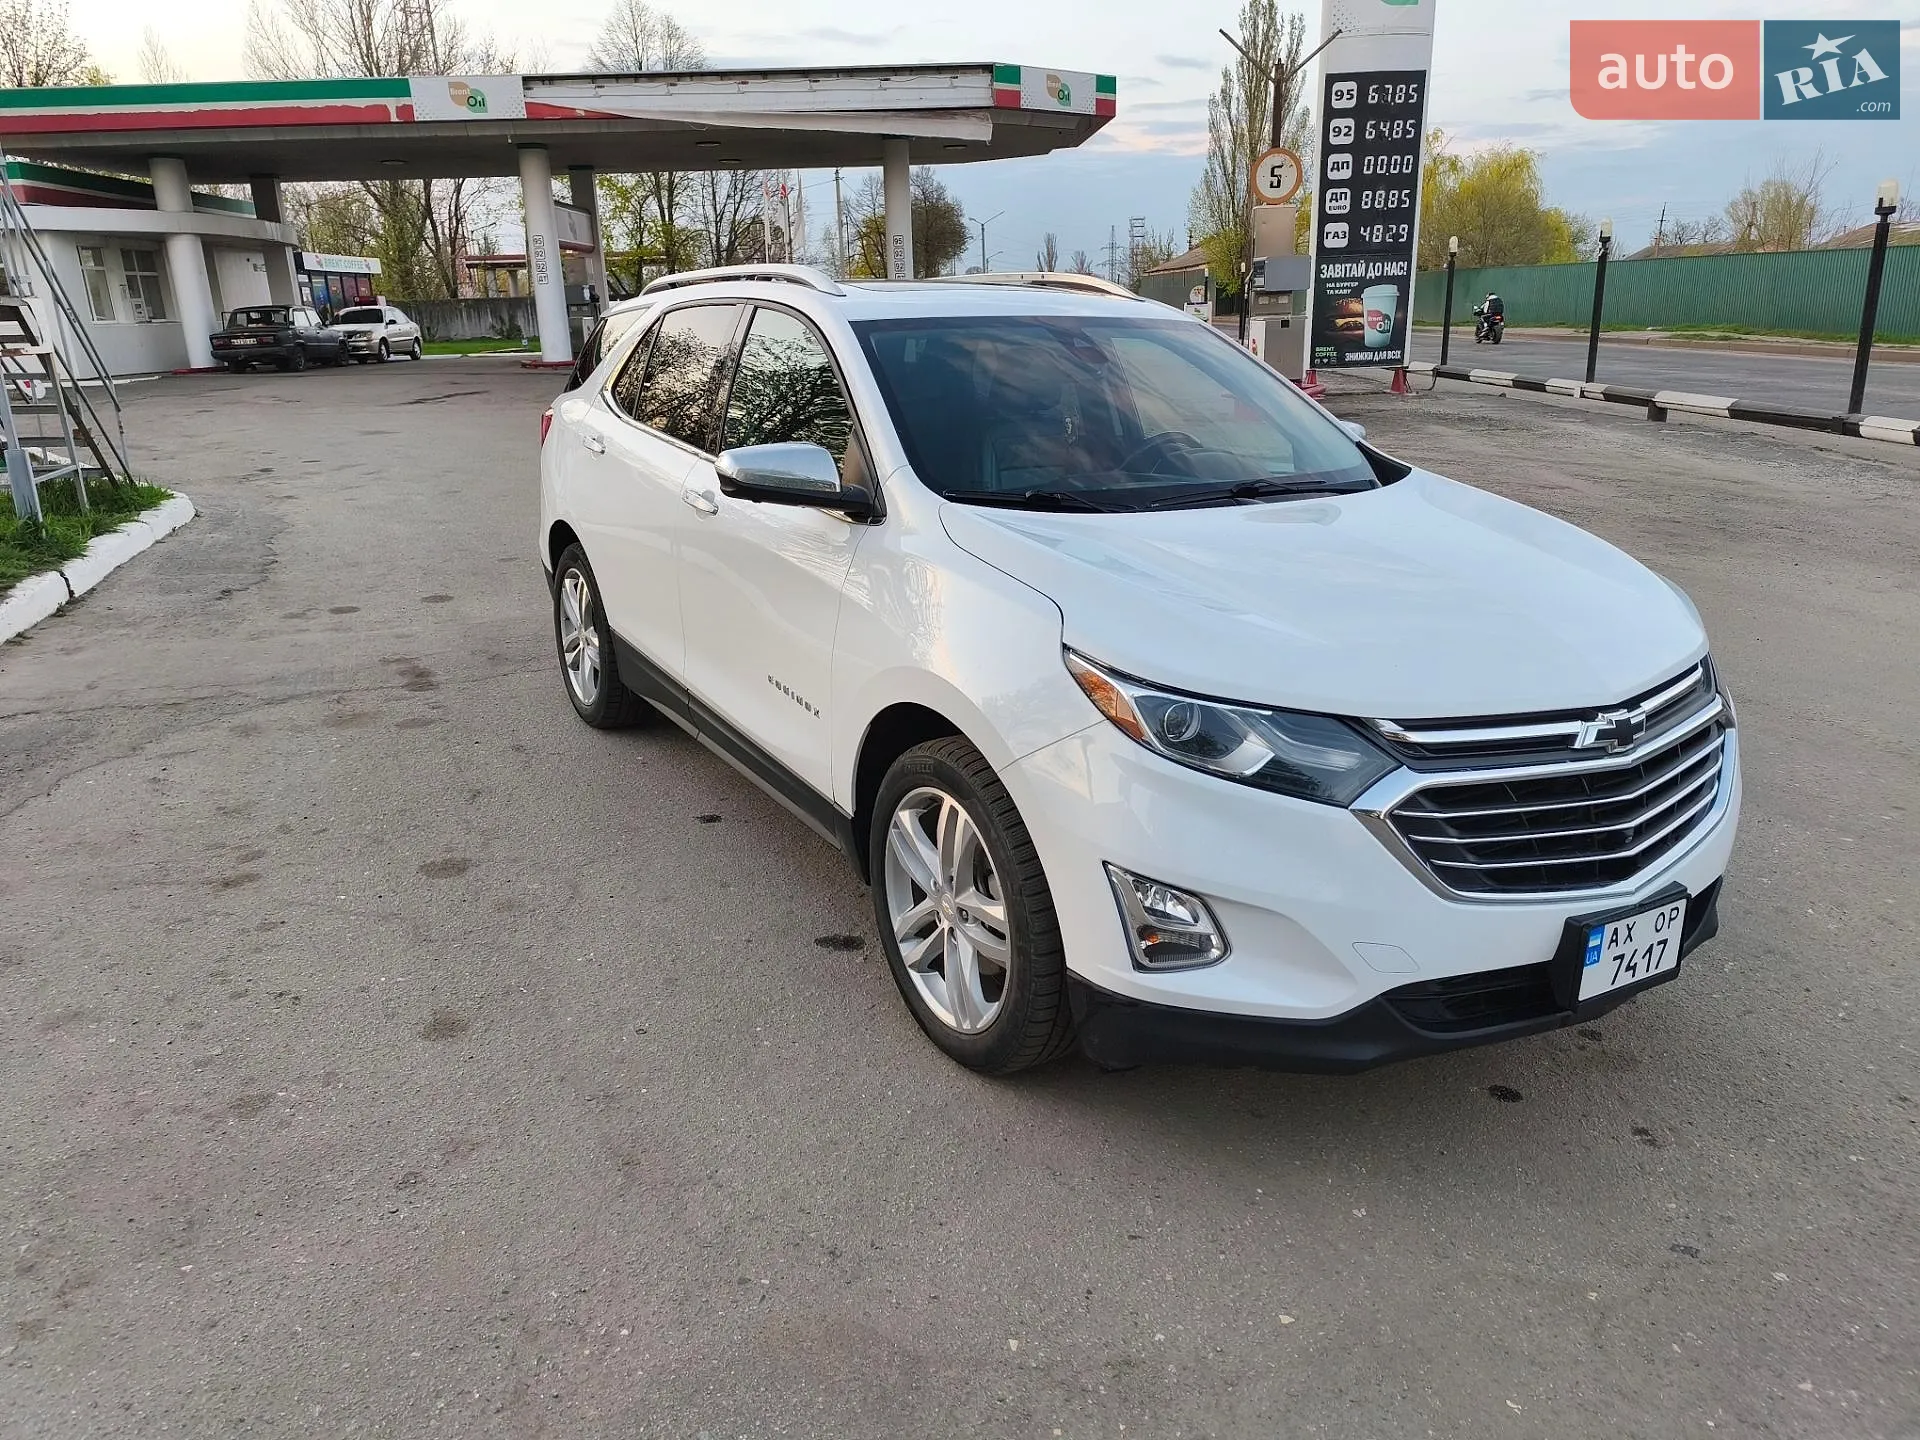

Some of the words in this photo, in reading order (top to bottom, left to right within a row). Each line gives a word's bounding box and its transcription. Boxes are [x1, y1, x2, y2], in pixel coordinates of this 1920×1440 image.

[467, 95, 485, 107] Oil
[1058, 89, 1070, 101] Oil
[1334, 88, 1355, 102] 95
[1367, 84, 1418, 106] 67.85
[1332, 125, 1352, 138] 92
[1365, 120, 1416, 141] 64.85
[1330, 160, 1350, 173] ДП
[1363, 155, 1413, 176] 00.00
[1269, 163, 1283, 189] 5
[1329, 191, 1348, 203] ДП
[1328, 204, 1347, 212] EURO
[1325, 230, 1347, 240] ГАЗ
[1320, 259, 1366, 279] ЗАВІТАЙ
[1366, 262, 1382, 279] ДО
[1383, 261, 1408, 277] НАС!
[1376, 319, 1390, 331] Oil
[1344, 352, 1373, 361] ЗНИЖКИ
[1373, 351, 1387, 362] ДЛЯ
[767, 674, 820, 720] EQUINOX
[1607, 921, 1637, 951] AX
[1654, 906, 1680, 934] OP
[1585, 954, 1599, 966] UA
[1610, 937, 1669, 986] 7417
